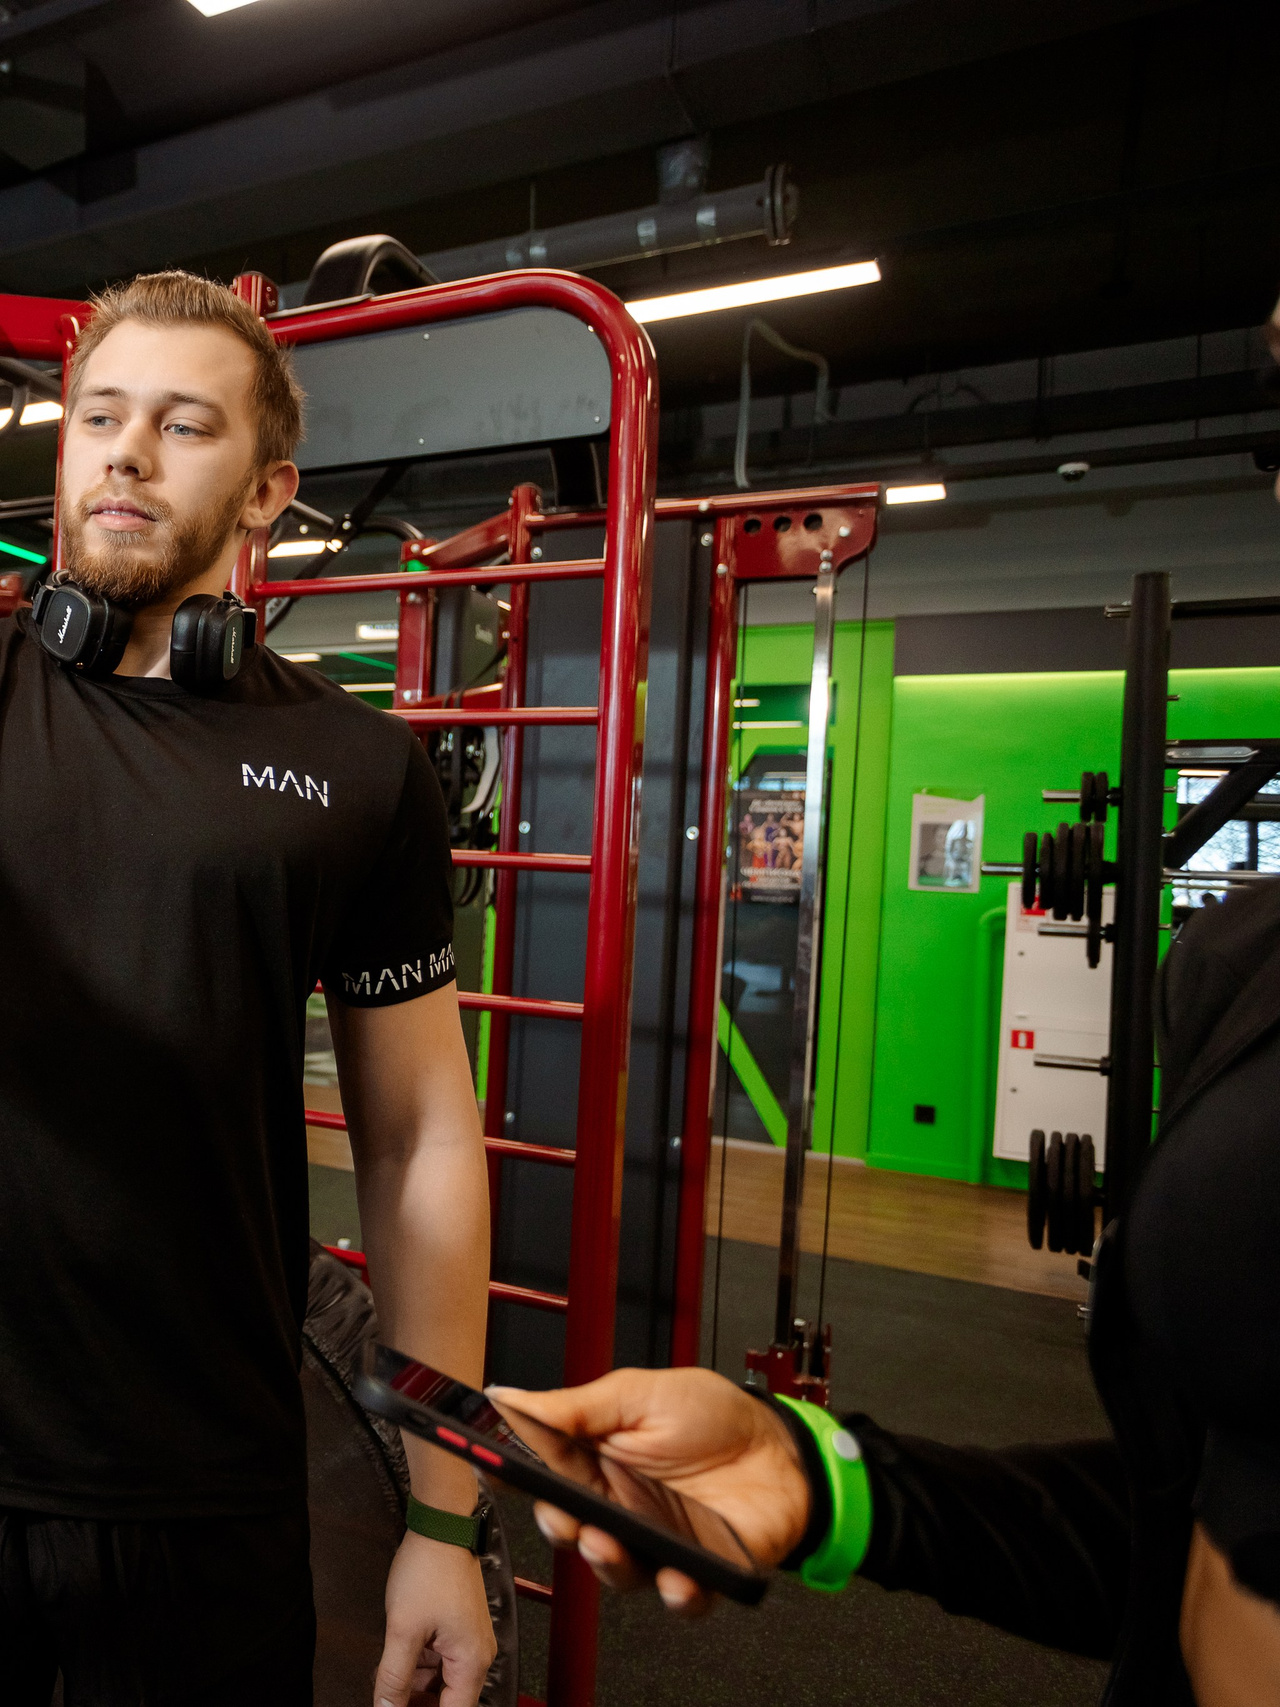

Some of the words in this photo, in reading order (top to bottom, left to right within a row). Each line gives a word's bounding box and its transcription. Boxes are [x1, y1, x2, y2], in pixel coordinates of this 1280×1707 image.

[57, 605, 72, 644] Marshall
[241, 763, 329, 808] MAN
[341, 959, 423, 996] MAN
[429, 942, 456, 978] MA
